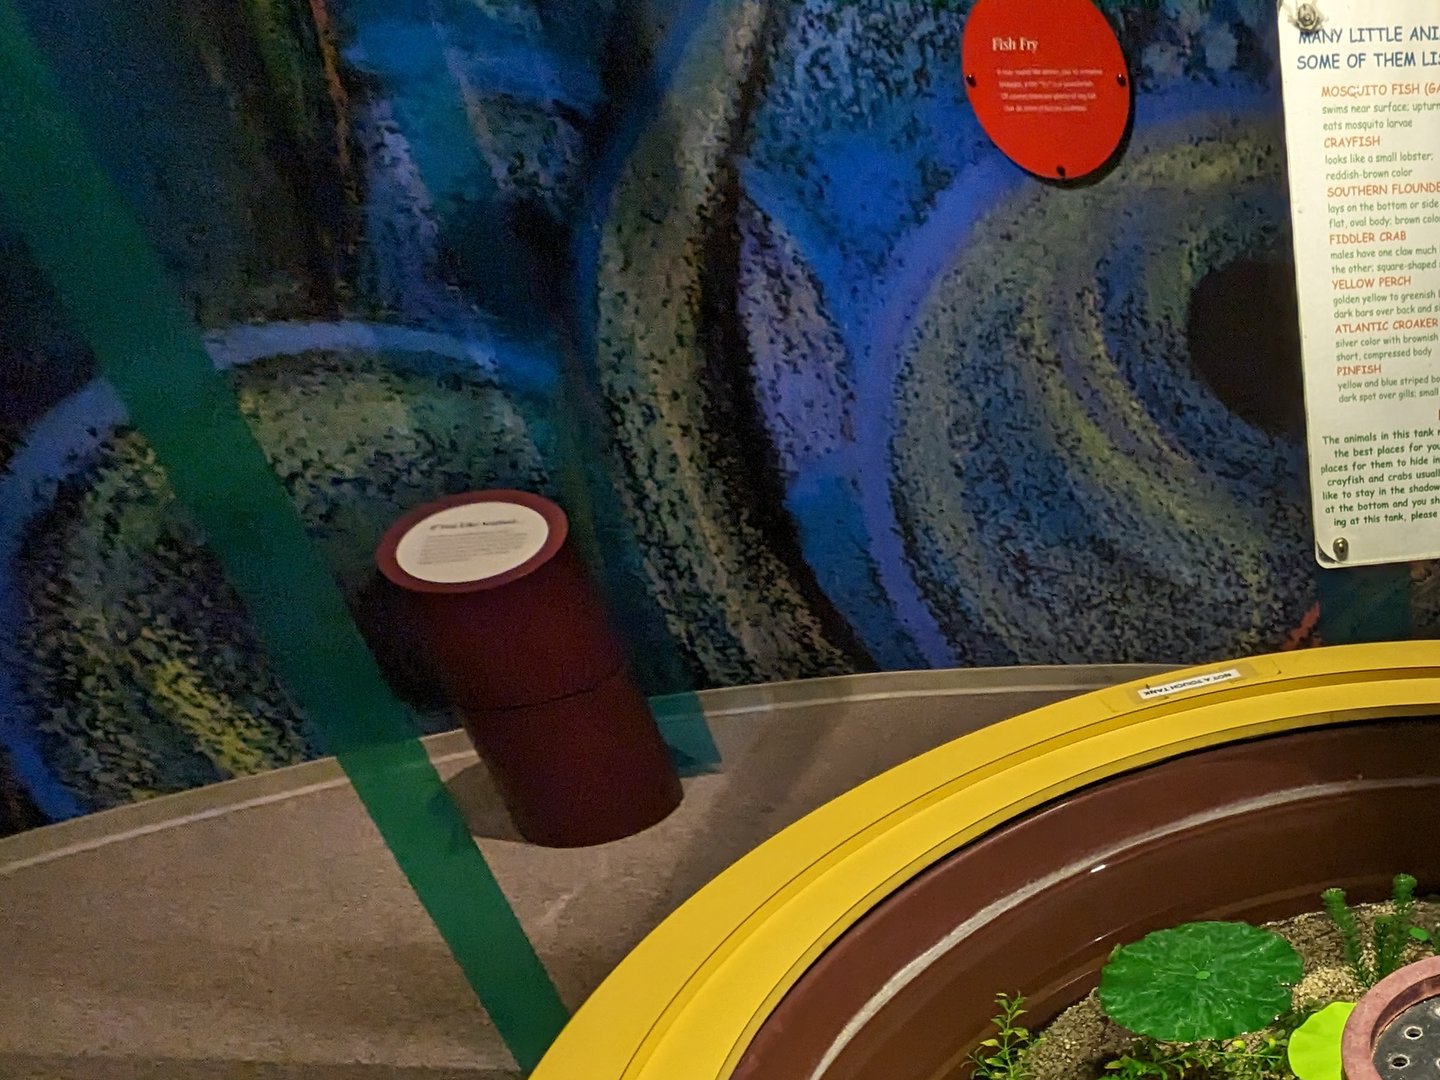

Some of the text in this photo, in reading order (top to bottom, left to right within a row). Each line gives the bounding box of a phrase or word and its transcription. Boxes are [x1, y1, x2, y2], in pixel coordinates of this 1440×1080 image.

[1299, 27, 1342, 43] MANY
[1350, 27, 1402, 42] LITTLE
[992, 36, 1038, 53] Fish Fry
[1297, 54, 1340, 69] SOME
[1347, 53, 1366, 68] OF
[1374, 52, 1416, 66] THEM
[1322, 85, 1387, 97] MOSQUITO
[1392, 84, 1420, 94] FISH
[1322, 106, 1348, 114] swims
[1374, 102, 1409, 112] surface;
[1323, 119, 1412, 130] eats mosquito larvae
[1324, 136, 1380, 147] CRAYFISH
[1328, 185, 1388, 197] SOUTHERN
[1330, 231, 1406, 244] FIDDLER CRAB
[1332, 276, 1411, 289] YELLOW PERCH
[1335, 318, 1438, 333] ATLANTIC CROAKER
[1337, 365, 1381, 375] PINFISH
[1322, 436, 1339, 444] The
[1344, 433, 1376, 442] animals
[1393, 430, 1409, 438] this
[1414, 428, 1434, 437] tank
[1334, 449, 1349, 457] the
[1353, 448, 1373, 456] best
[1378, 446, 1404, 456] places
[1409, 443, 1423, 452] for
[1321, 464, 1348, 474] places
[1352, 462, 1366, 470] for
[1371, 460, 1393, 468] them
[1410, 457, 1428, 465] hide
[1327, 475, 1364, 486] crayfish
[1368, 474, 1384, 482] and
[1388, 472, 1412, 481] crabs
[1356, 489, 1375, 498] stay
[1390, 486, 1404, 494] the
[1339, 504, 1353, 512] the
[1358, 502, 1389, 510] bottom
[1393, 498, 1408, 507] and
[1412, 499, 1426, 508] you
[1334, 518, 1346, 528] ing
[1364, 515, 1380, 523] this
[1384, 513, 1406, 521] tank,
[1411, 511, 1437, 521] please
[1171, 680, 1202, 689] TOUCH
[1144, 688, 1170, 696] TANK
